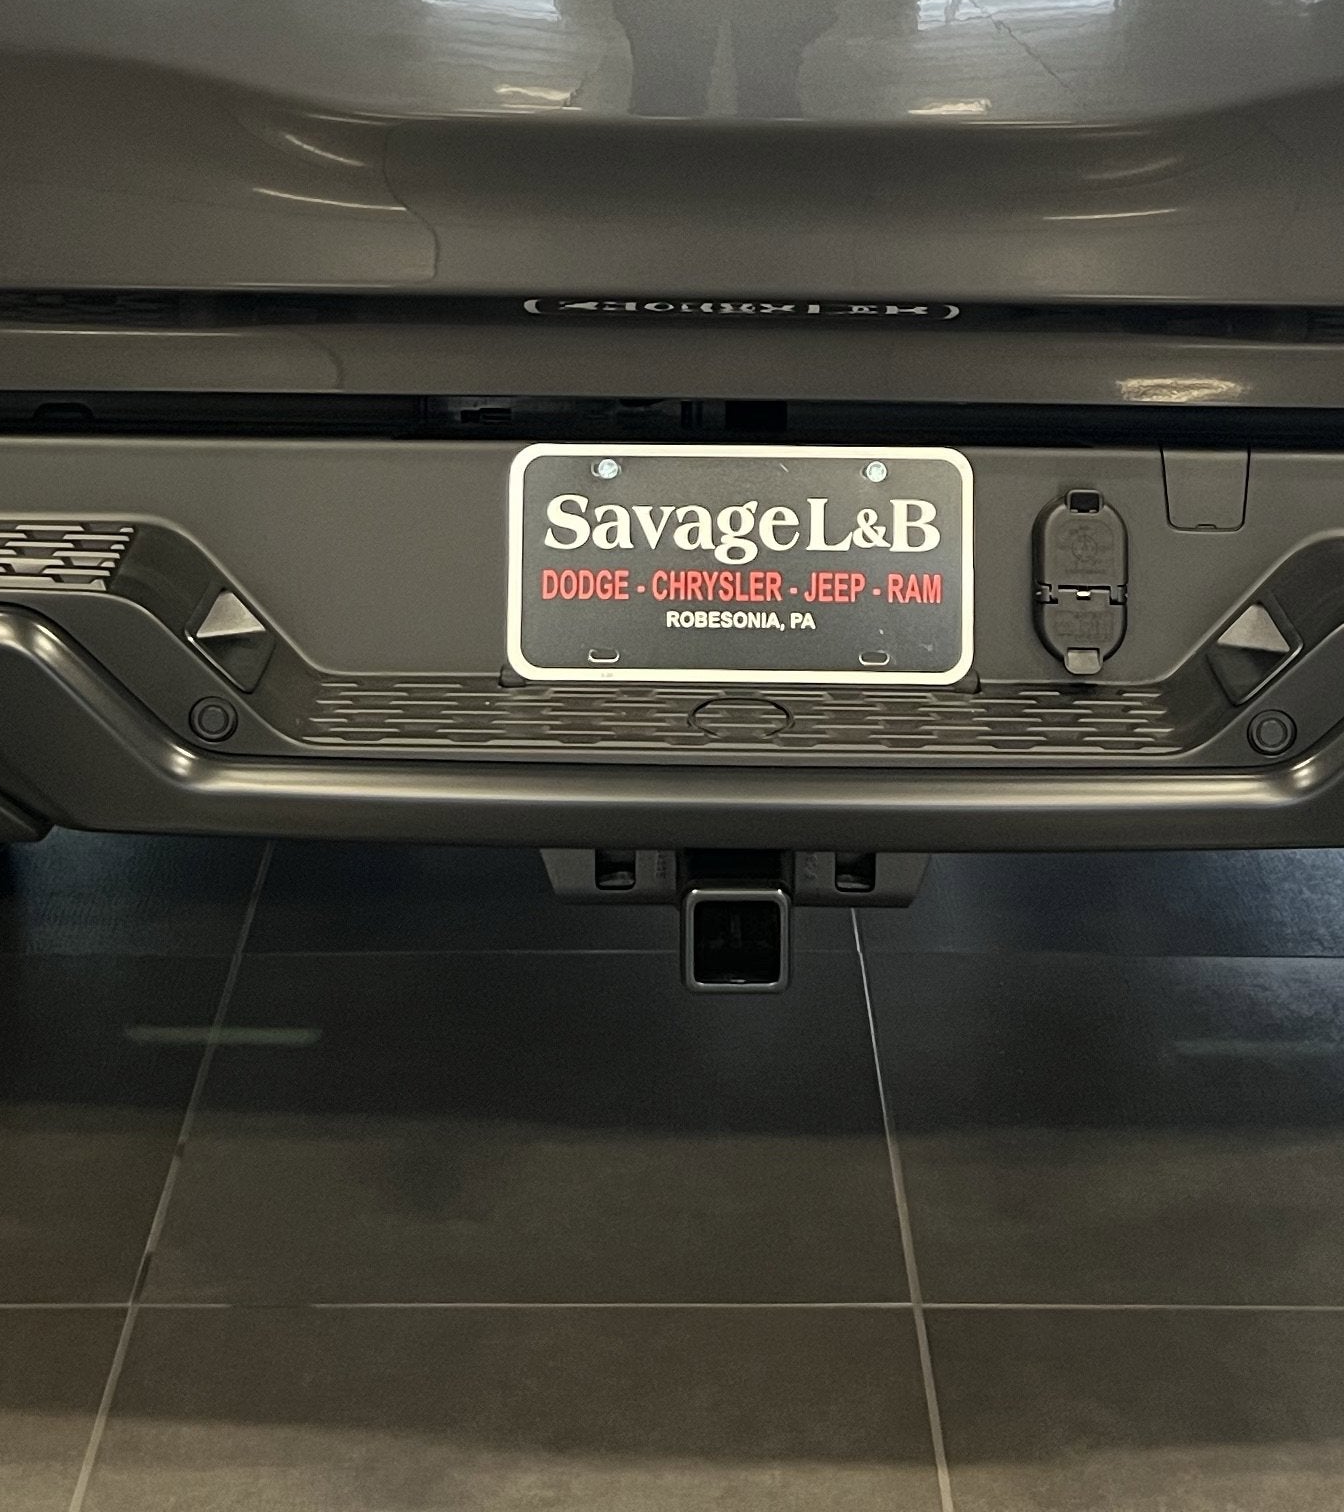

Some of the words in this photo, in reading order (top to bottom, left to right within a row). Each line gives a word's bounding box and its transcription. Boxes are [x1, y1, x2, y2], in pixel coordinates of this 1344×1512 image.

[541, 569, 630, 601] DODGE
[652, 570, 782, 603] CHRYSLER
[804, 572, 866, 604] JEEP
[887, 574, 942, 605] RAM
[666, 610, 786, 632] ROBESONIA,
[790, 611, 816, 630] PA
